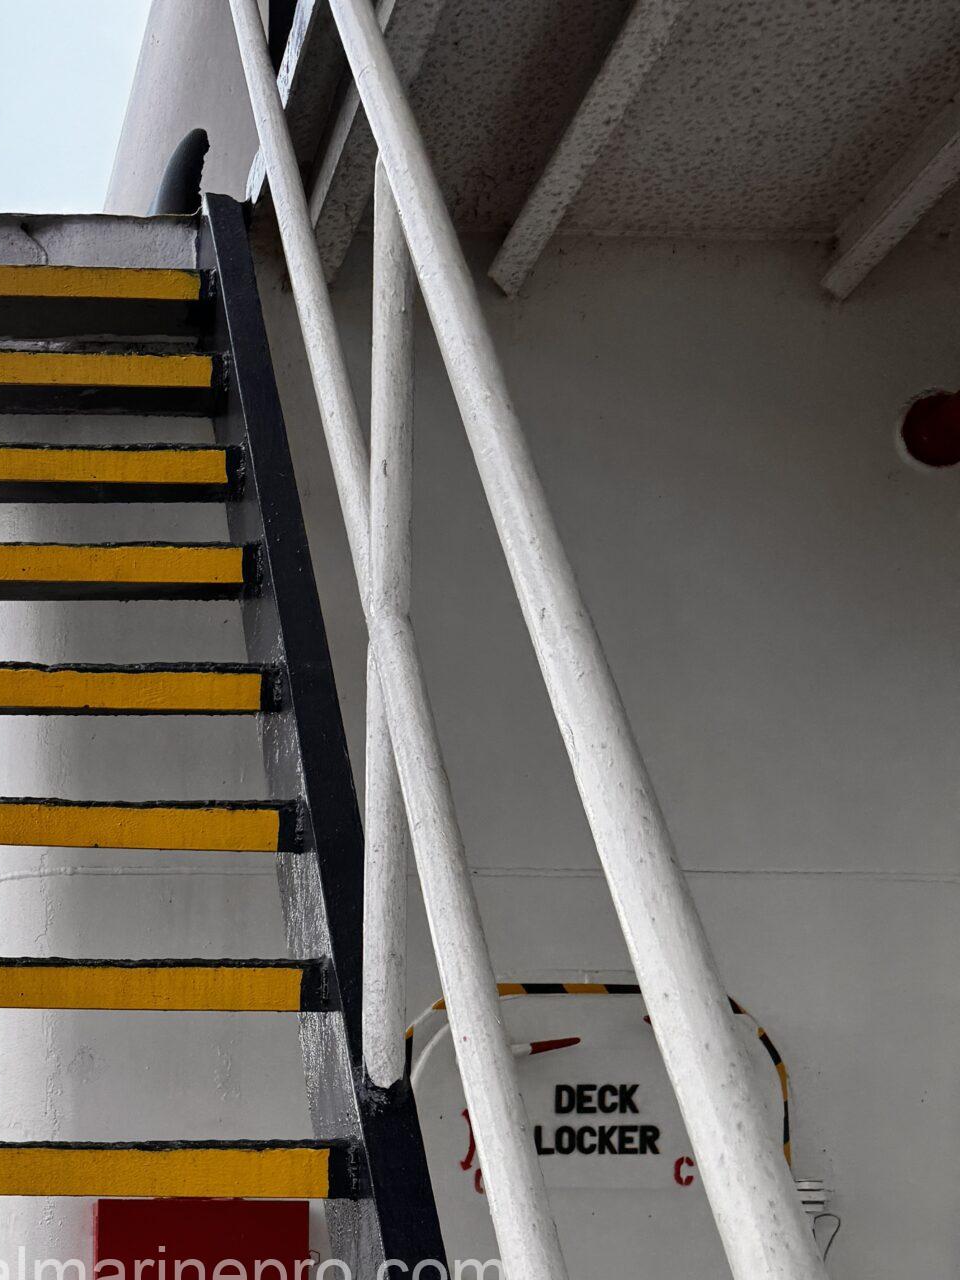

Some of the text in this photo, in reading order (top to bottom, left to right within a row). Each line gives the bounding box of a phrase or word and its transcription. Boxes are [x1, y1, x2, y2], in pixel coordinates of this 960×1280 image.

[554, 1084, 639, 1114] DECK
[534, 1125, 660, 1155] LOCKER
[673, 1156, 694, 1186] C
